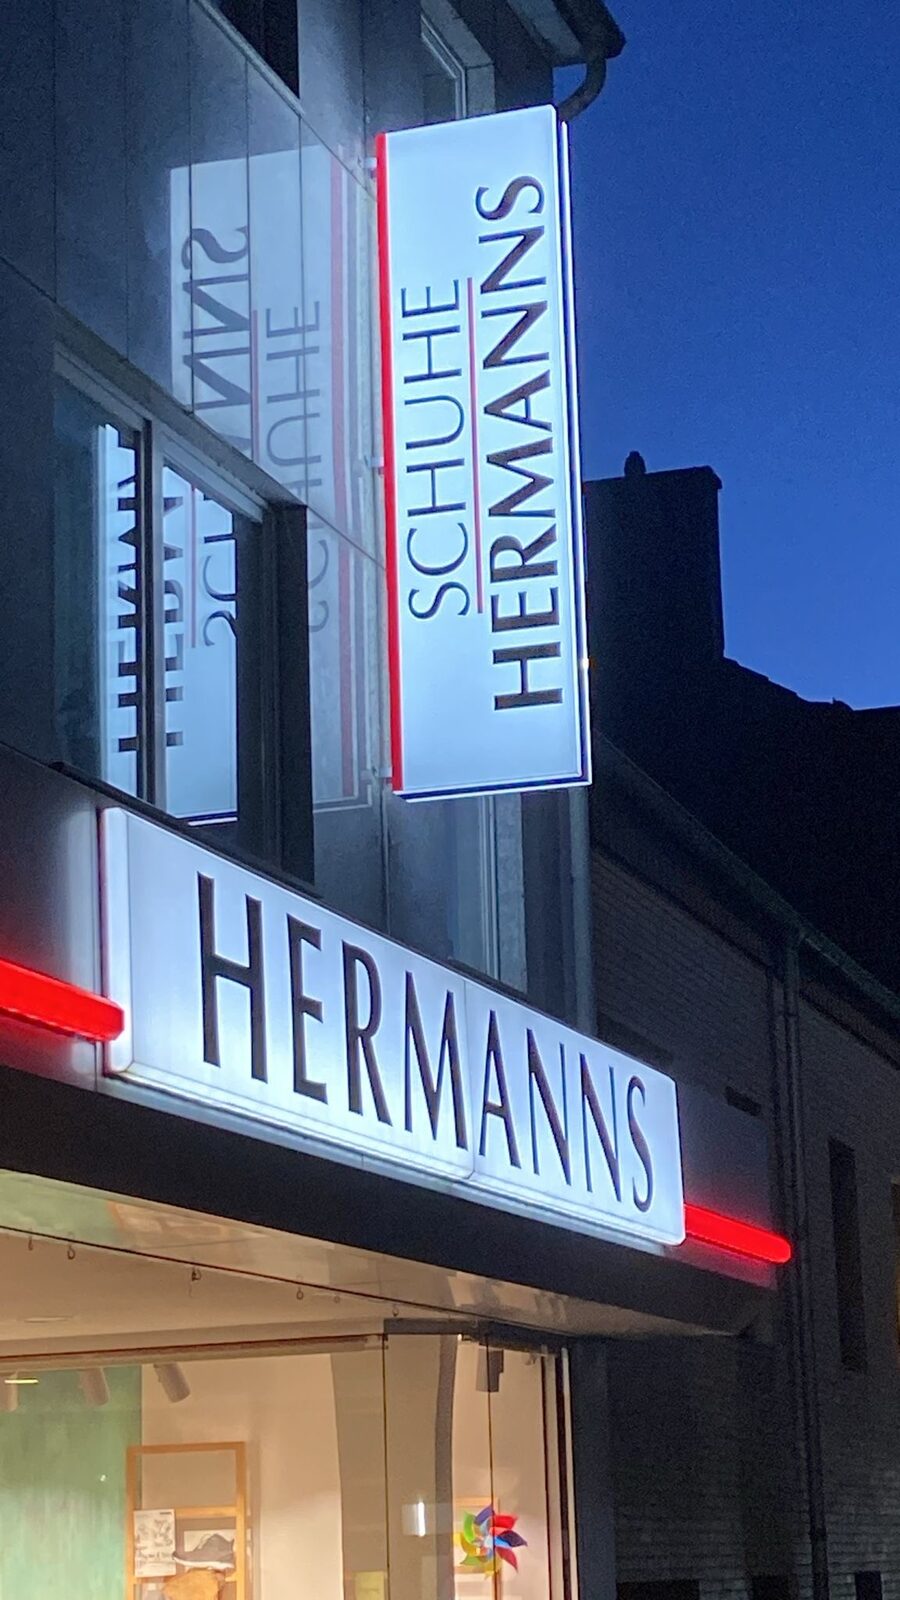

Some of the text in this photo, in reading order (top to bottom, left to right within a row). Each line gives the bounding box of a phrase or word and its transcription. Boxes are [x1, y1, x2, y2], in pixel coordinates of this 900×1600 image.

[401, 279, 470, 619] SCHUHE
[475, 175, 563, 711] HERMANNS
[197, 870, 655, 1212] HERMANNS
